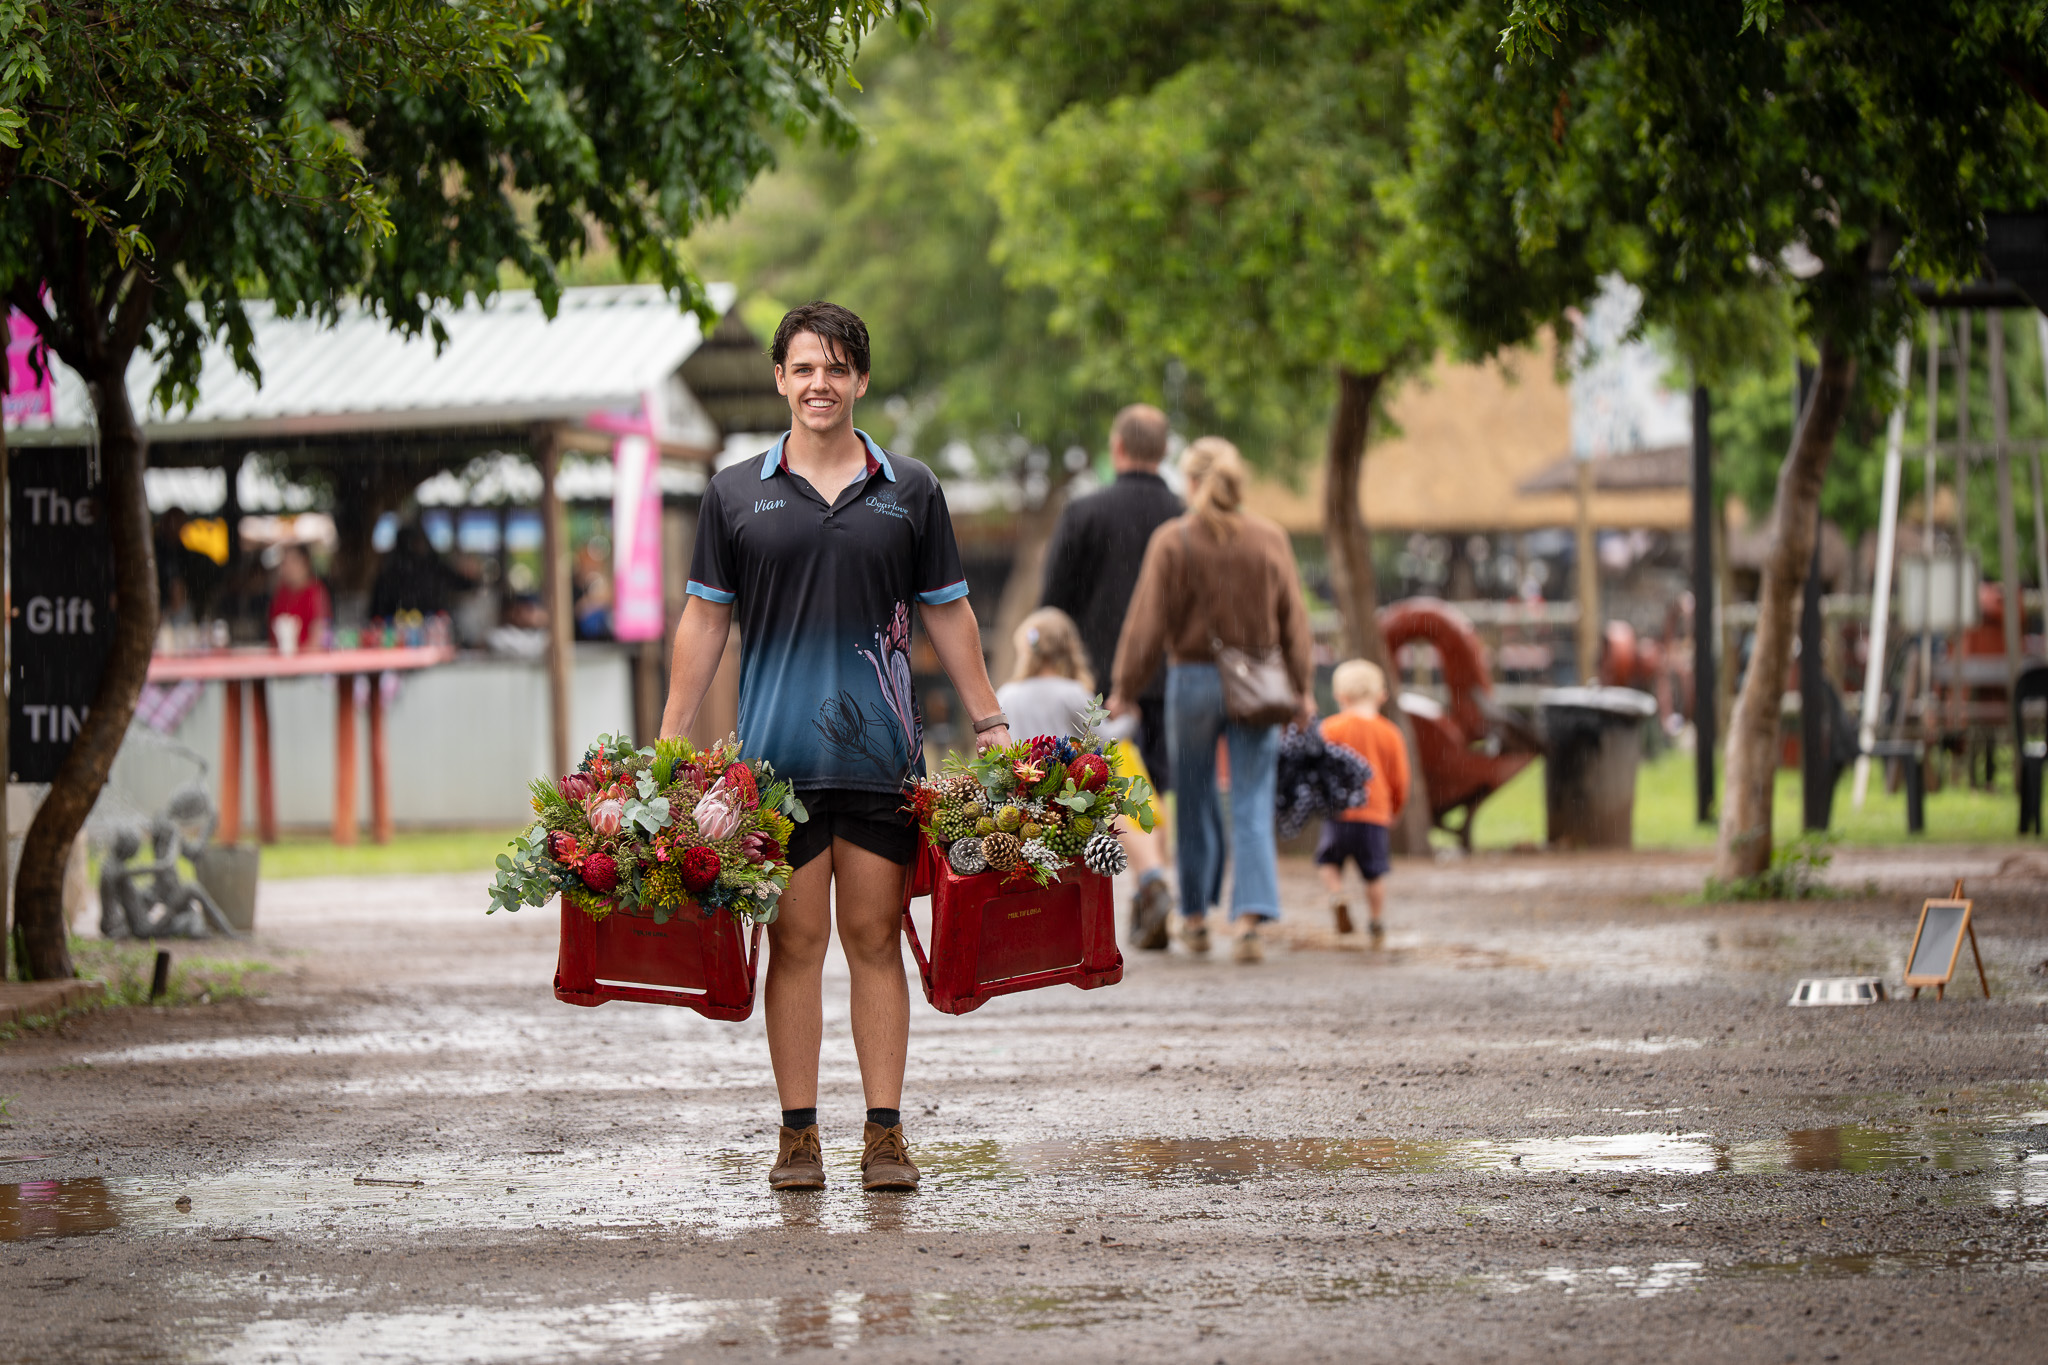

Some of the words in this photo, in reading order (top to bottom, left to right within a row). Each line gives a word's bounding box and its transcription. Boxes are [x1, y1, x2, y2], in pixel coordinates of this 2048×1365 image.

[23, 487, 94, 526] The
[754, 499, 787, 514] Vian
[865, 496, 909, 515] Dearlove
[26, 595, 95, 635] Gift
